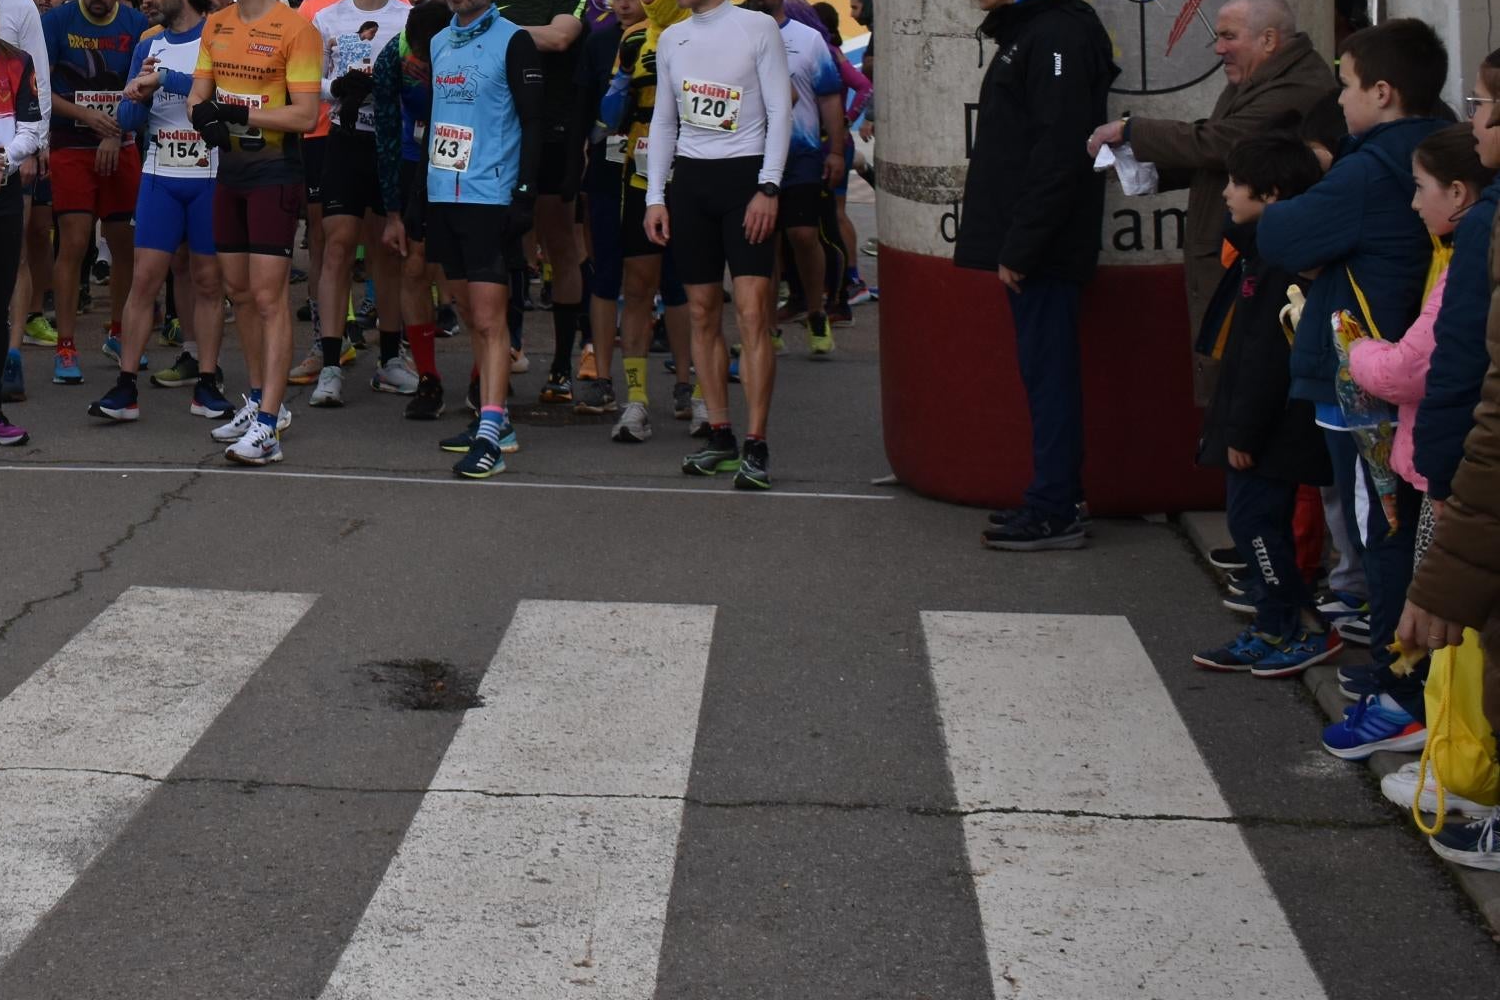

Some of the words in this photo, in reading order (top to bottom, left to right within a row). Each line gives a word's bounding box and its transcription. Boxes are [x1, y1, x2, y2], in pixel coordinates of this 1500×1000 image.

[116, 32, 132, 53] Z
[691, 96, 726, 118] 120
[168, 142, 199, 158] 154
